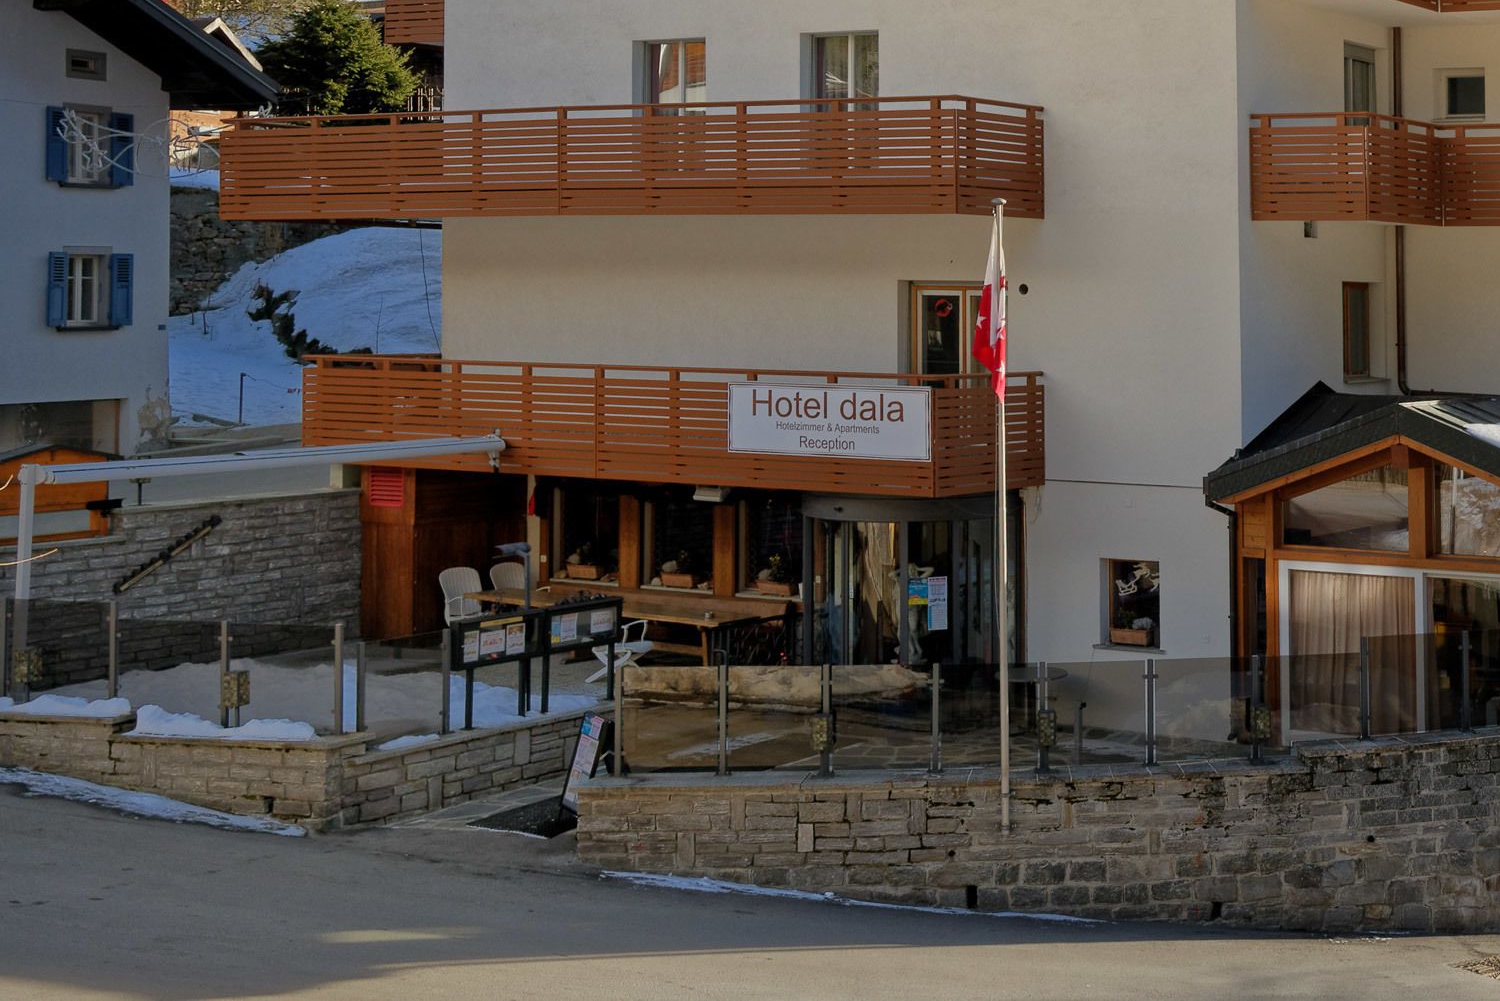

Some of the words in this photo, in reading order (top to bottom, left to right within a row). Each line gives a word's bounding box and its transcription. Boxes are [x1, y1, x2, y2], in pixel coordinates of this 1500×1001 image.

[752, 389, 828, 419] Hotel
[840, 392, 904, 422] dala
[776, 421, 825, 431] Hotelzimmer
[827, 423, 833, 432] &
[834, 423, 880, 434] Apartments
[799, 435, 855, 452] Reception
